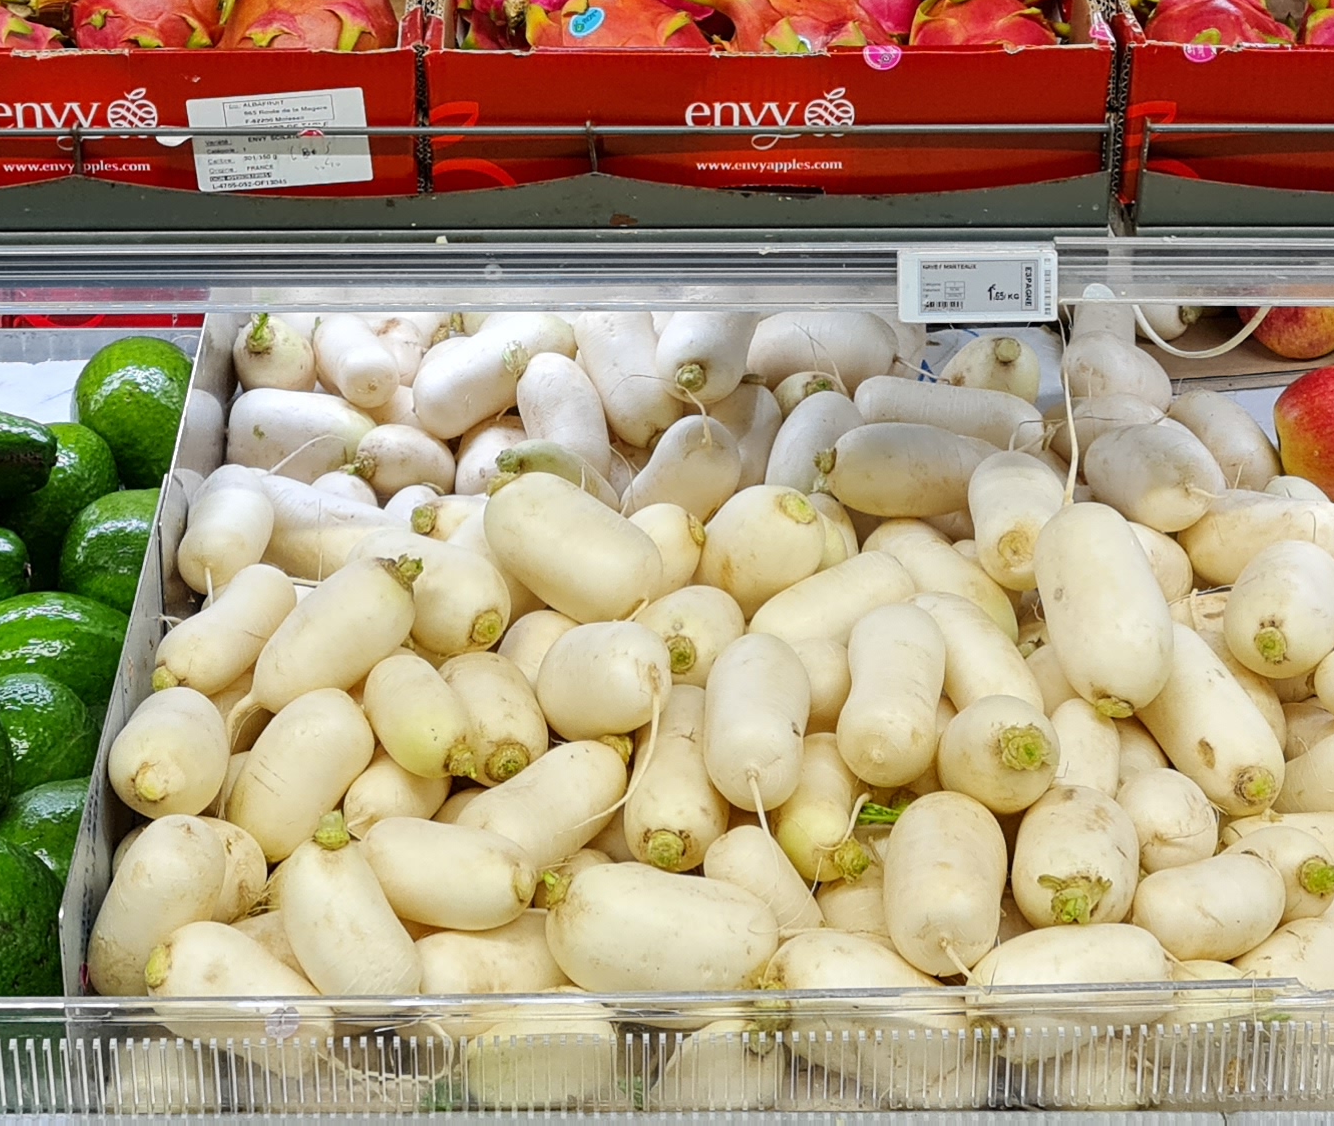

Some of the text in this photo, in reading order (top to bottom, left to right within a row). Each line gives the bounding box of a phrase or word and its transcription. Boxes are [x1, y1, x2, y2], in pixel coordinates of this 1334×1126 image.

[684, 101, 802, 150] envy
[3, 161, 151, 174] www.envypples.com
[247, 164, 274, 172] FRANCE
[696, 159, 843, 173] www.envyapples.com
[1024, 266, 1032, 307] ESPAGNE
